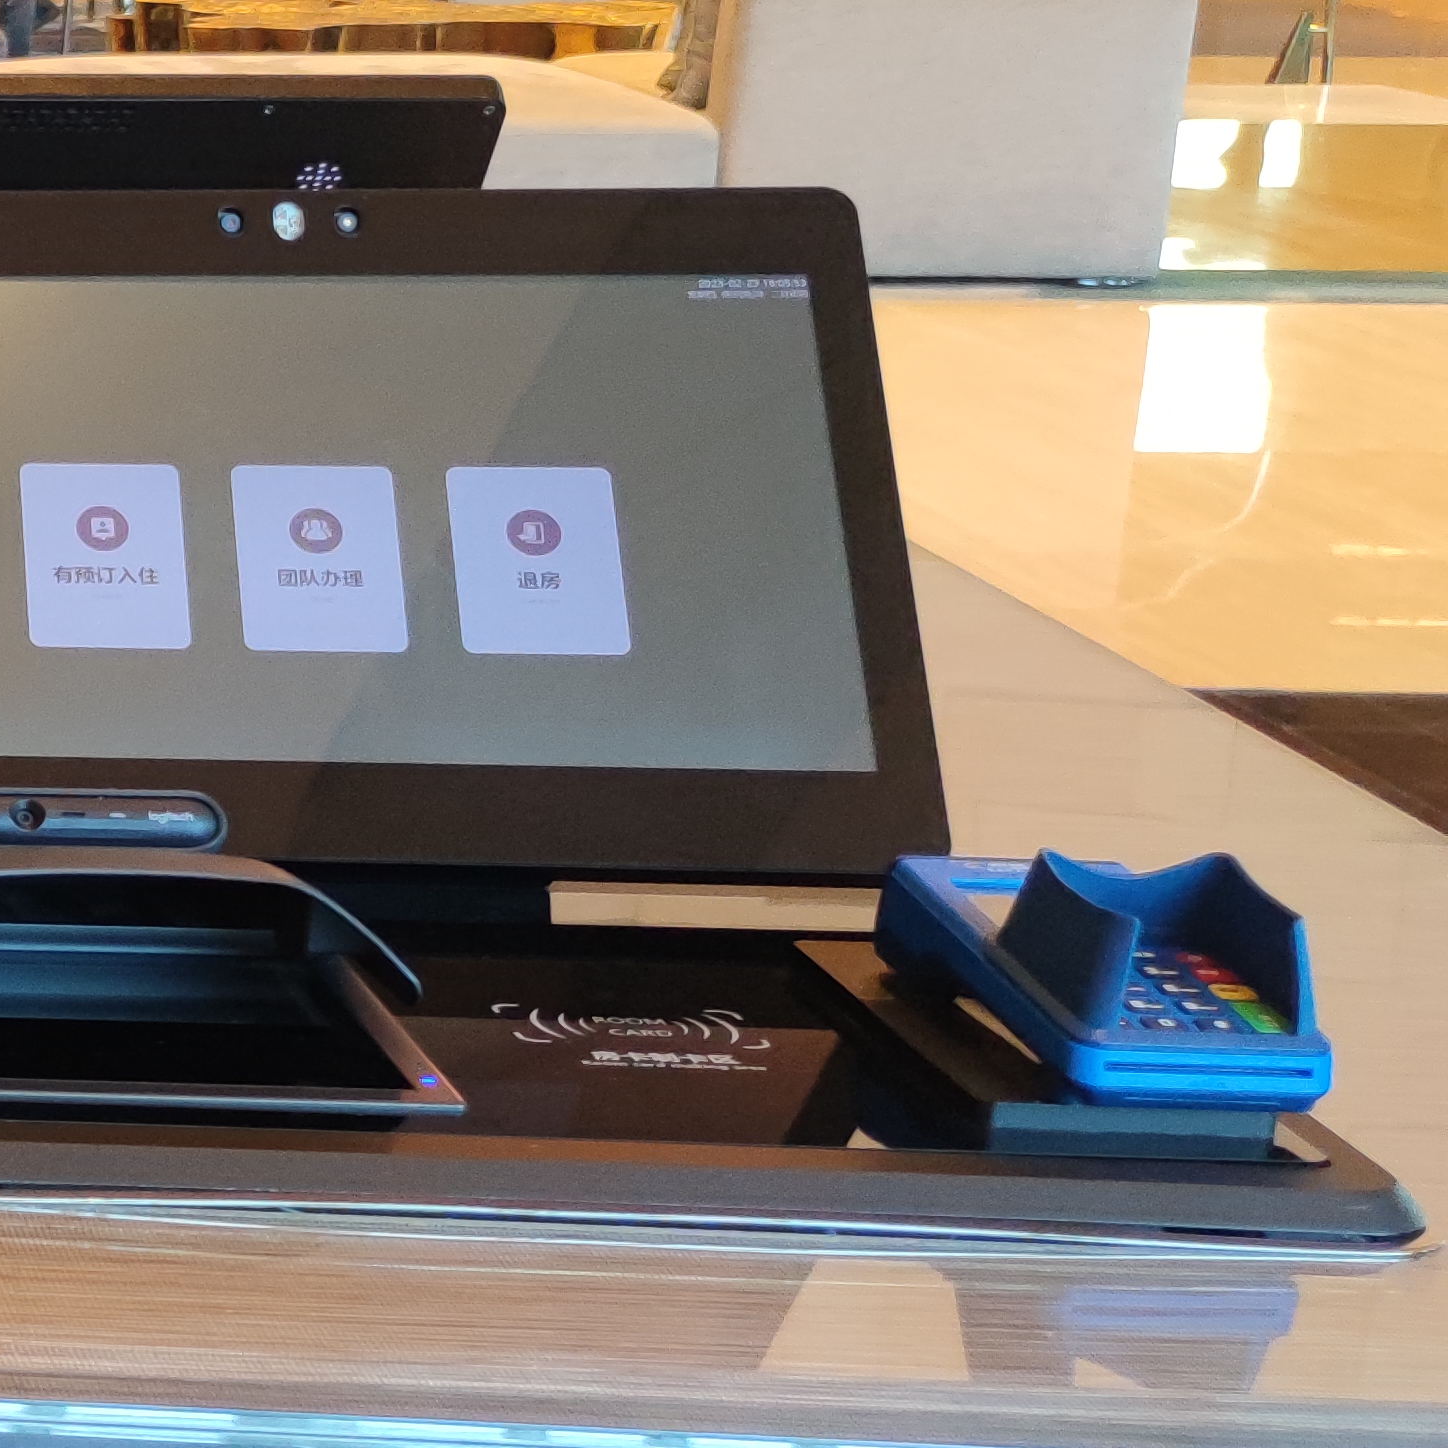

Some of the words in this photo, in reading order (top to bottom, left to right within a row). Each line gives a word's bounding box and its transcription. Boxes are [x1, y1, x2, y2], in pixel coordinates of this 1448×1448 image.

[52, 565, 160, 585] 有预订入住
[277, 569, 364, 587] 团队办理
[517, 571, 561, 590] 退房
